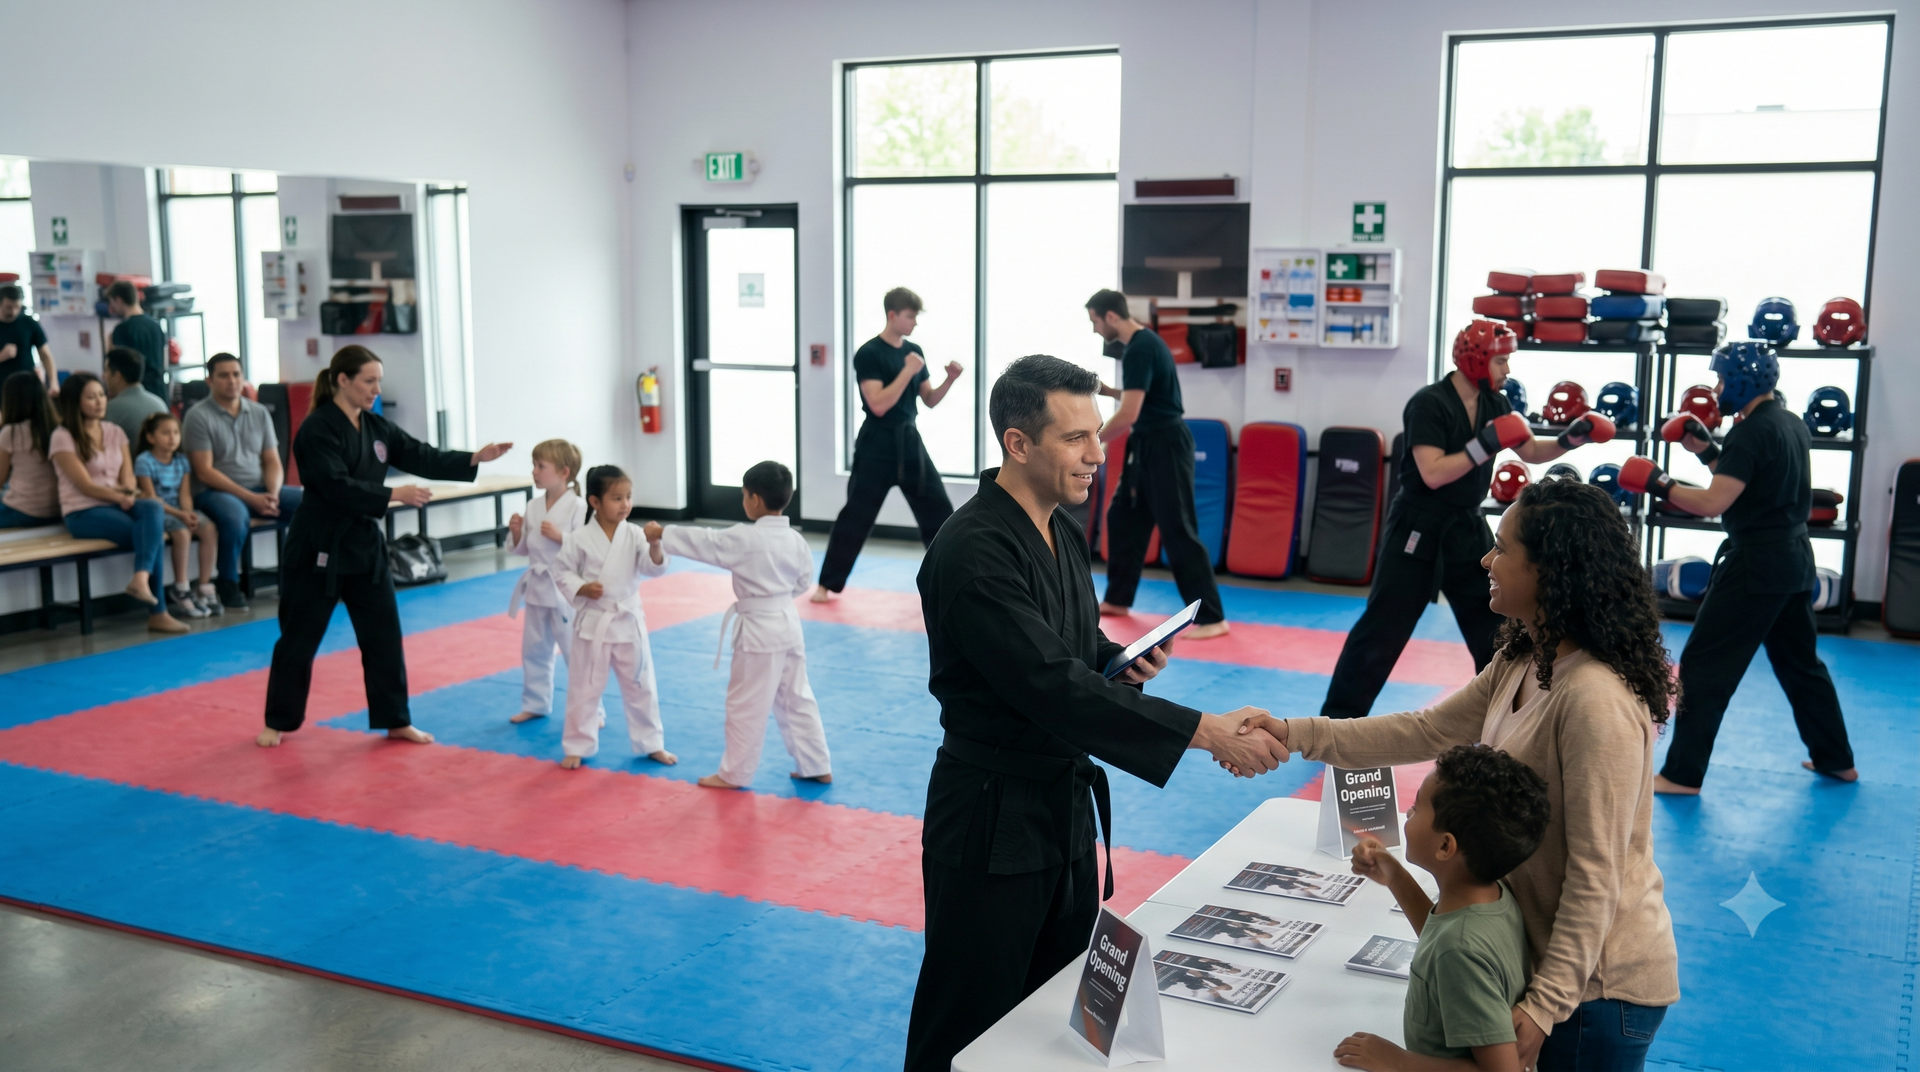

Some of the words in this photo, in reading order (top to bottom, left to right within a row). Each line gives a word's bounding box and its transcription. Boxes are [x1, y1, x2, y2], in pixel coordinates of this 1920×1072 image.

[709, 155, 737, 179] EXIT
[1345, 768, 1382, 785] Grand
[1340, 785, 1391, 804] Opening
[1100, 934, 1129, 966] Grand
[1090, 950, 1127, 992] Opening
